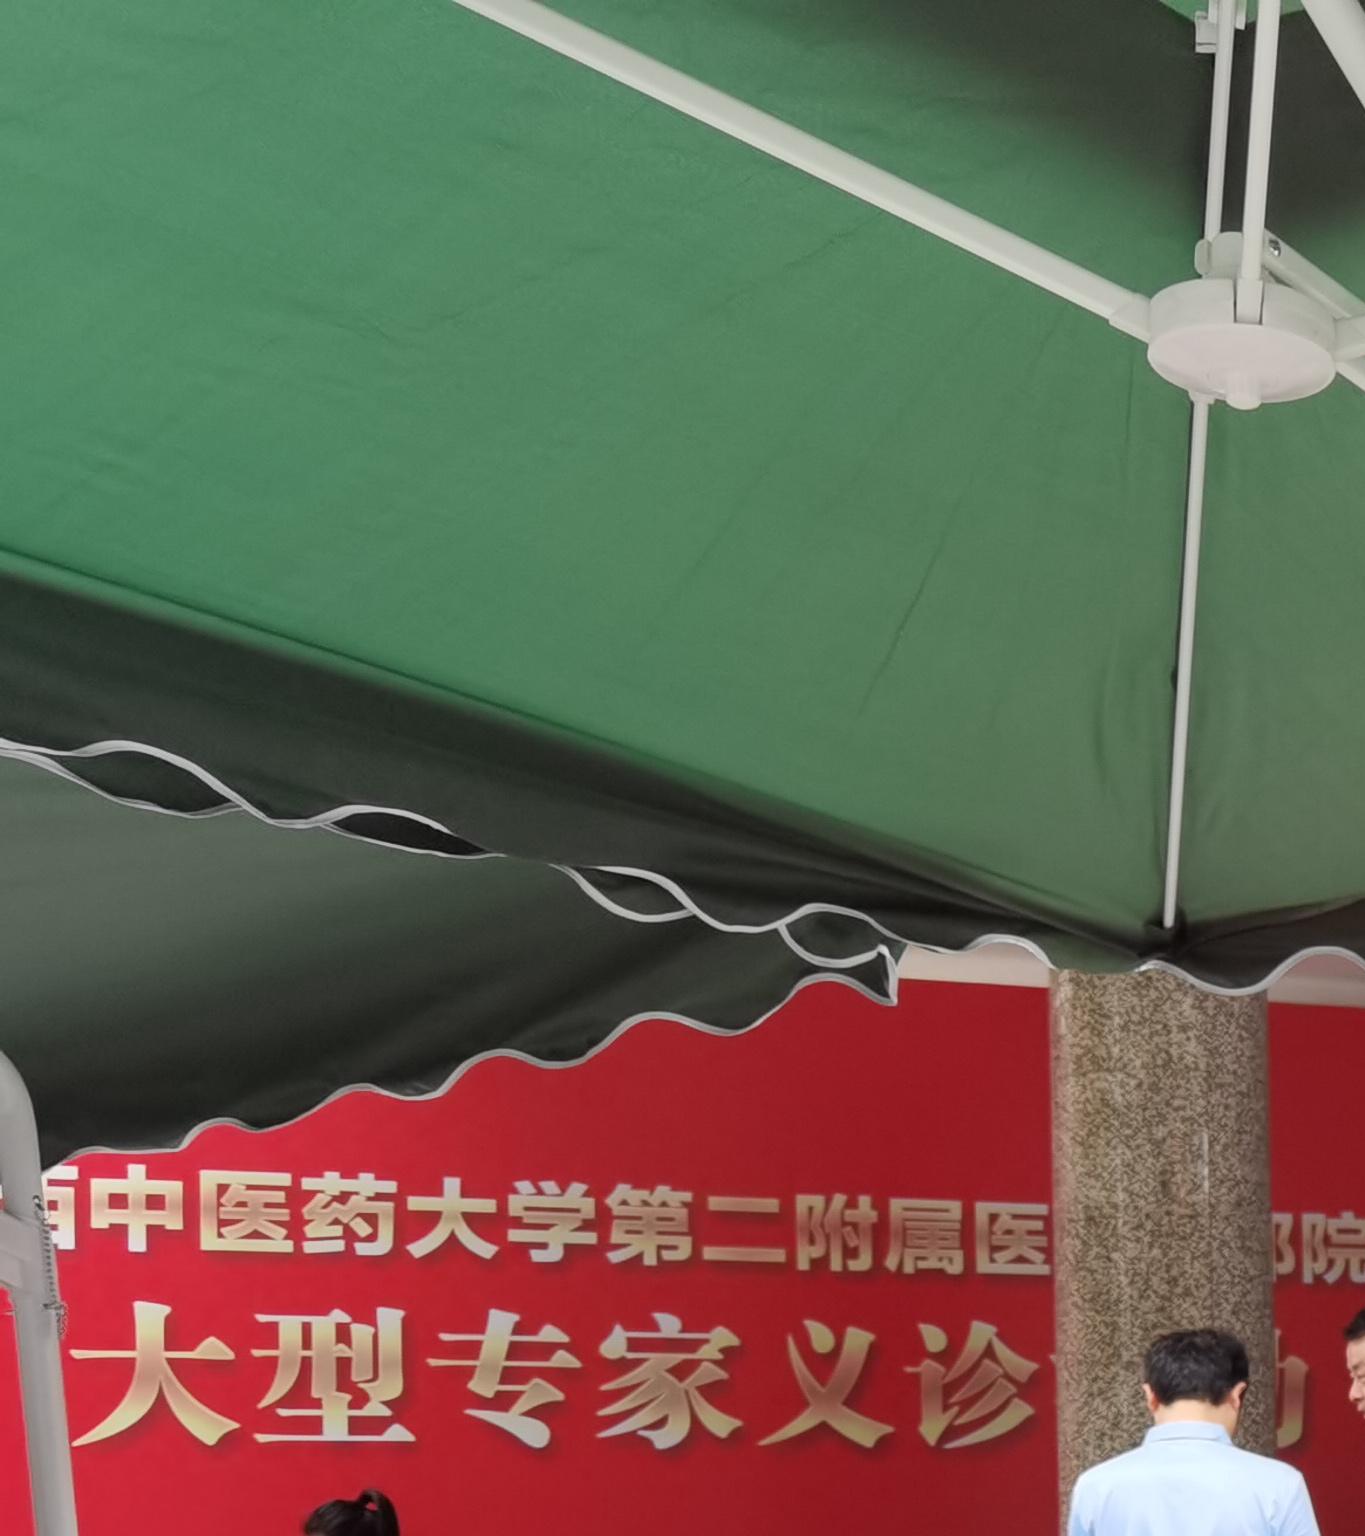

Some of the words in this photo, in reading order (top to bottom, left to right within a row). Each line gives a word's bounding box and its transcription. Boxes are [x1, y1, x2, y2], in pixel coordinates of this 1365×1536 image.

[70, 1299, 1040, 1451] 大型专家义诊
